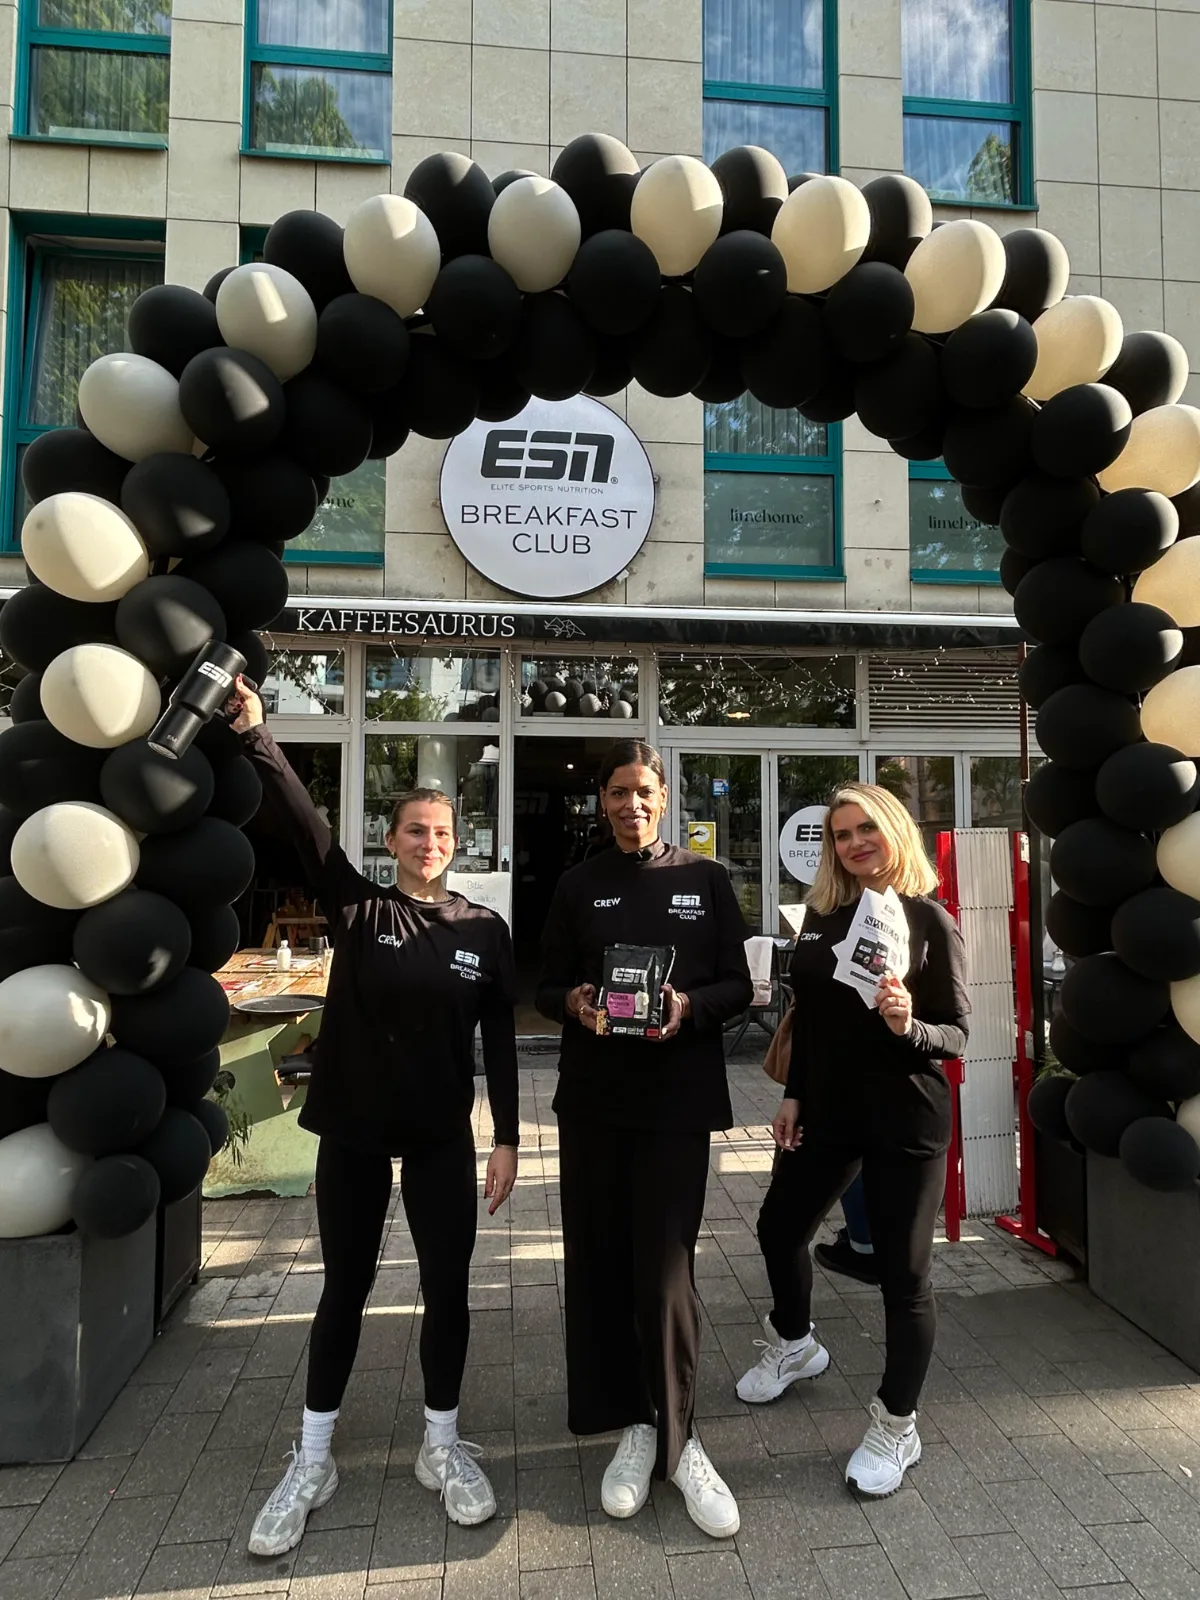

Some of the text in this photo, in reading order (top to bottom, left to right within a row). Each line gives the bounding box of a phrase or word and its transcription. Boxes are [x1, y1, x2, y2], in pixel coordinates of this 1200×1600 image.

[490, 483, 604, 495] ELITE SPORTS NUTRITION
[461, 504, 638, 529] BREAKFAST
[730, 508, 804, 524] limehome
[512, 533, 591, 555] CLUB
[296, 608, 516, 638] KAFFEESAURUS
[198, 661, 233, 689] ESN
[594, 897, 621, 908] CREW
[672, 894, 700, 906] ESN
[668, 908, 706, 916] BREAKFAST
[378, 934, 403, 948] CREW
[800, 932, 823, 941] CREW
[455, 949, 480, 967] ESN
[460, 971, 477, 981] CLUB
[611, 967, 648, 984] ESN
